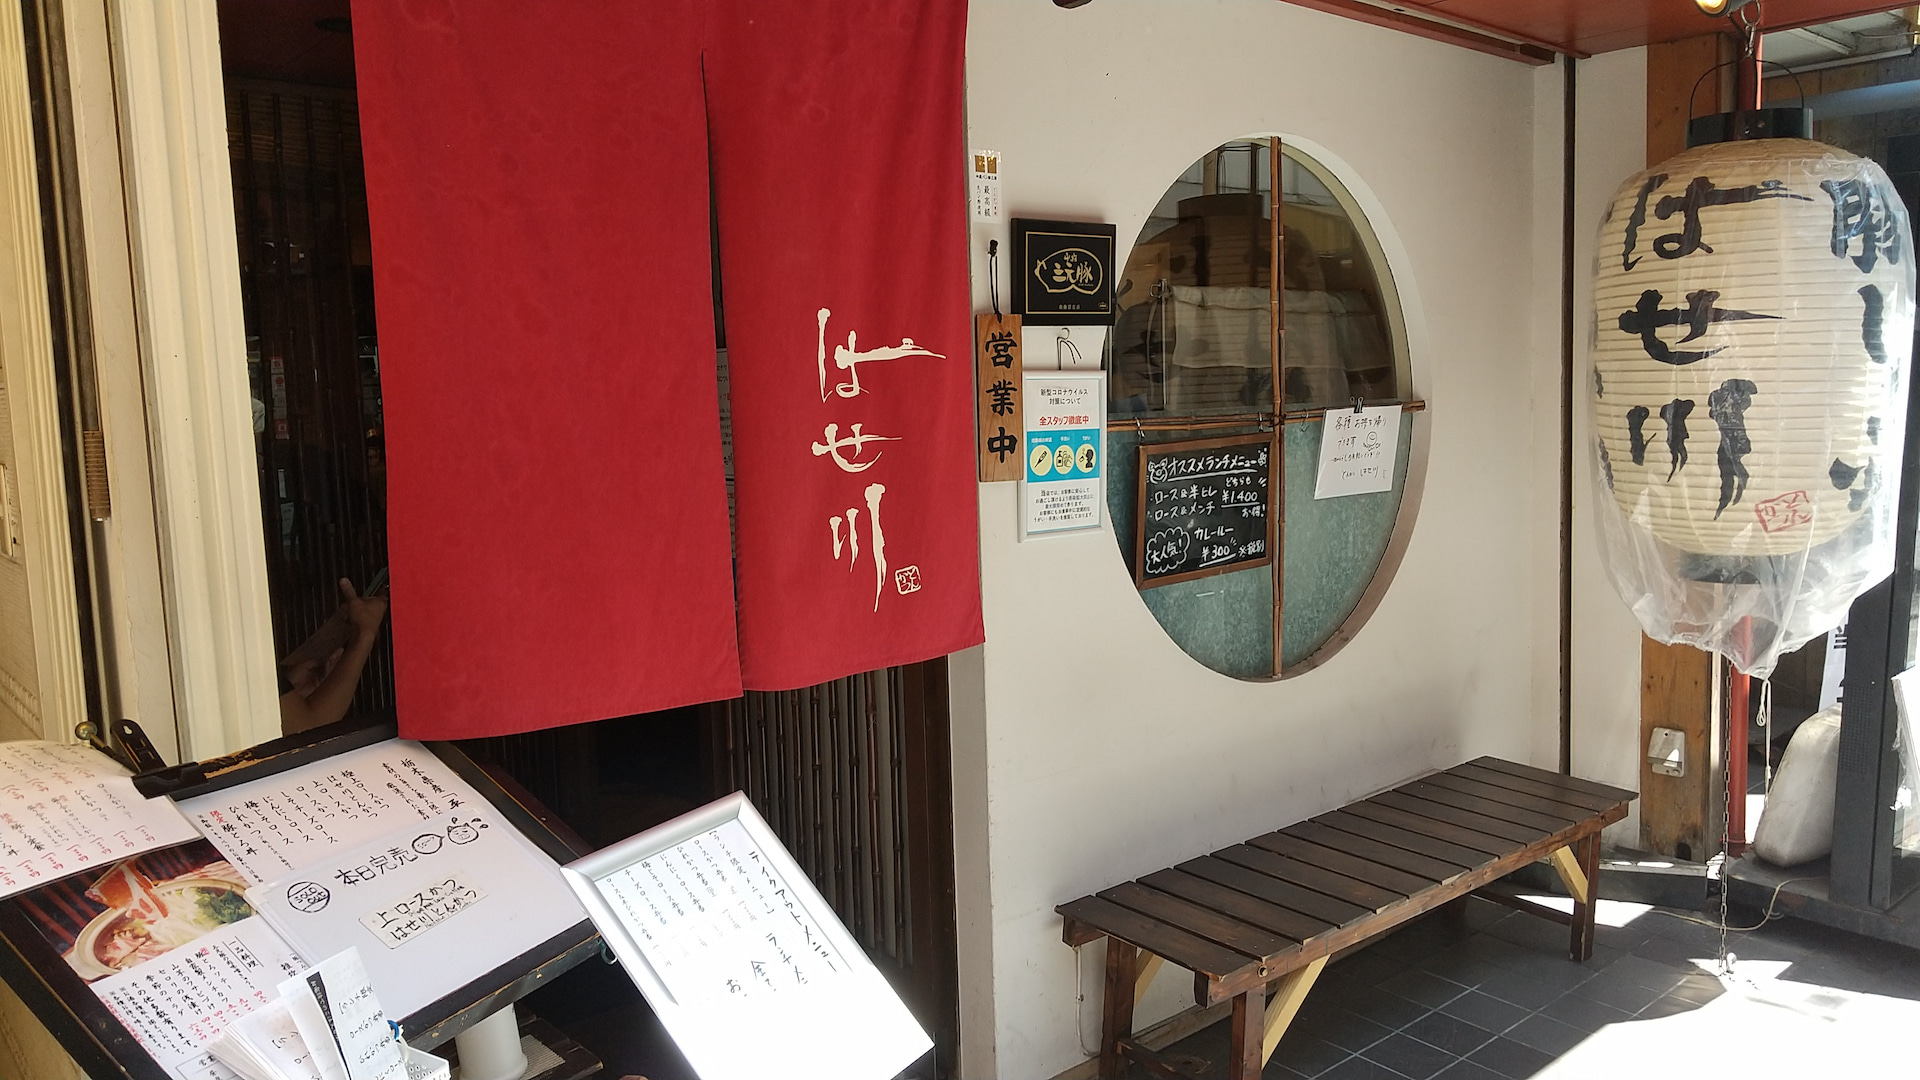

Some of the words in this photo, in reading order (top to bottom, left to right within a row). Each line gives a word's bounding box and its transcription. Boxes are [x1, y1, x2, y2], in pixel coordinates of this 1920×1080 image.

[1617, 172, 1814, 521] はせ川
[985, 331, 1018, 464] 営業中
[1039, 415, 1089, 426] 全スタッフ徹底中
[811, 307, 947, 613] はせ川
[1167, 454, 1258, 477] オススメランチメニュー
[1225, 476, 1252, 487] どちらも
[1194, 525, 1235, 541] カレールー
[296, 786, 335, 818] ロースかつ
[312, 781, 358, 819] 上ロースかつ
[327, 775, 377, 817] はせ川とんかつ
[341, 770, 389, 808] 極上ロースかつ
[229, 806, 261, 834] ひれかつ
[263, 796, 314, 842] にんにくロース
[281, 792, 338, 844] しそチーズロース
[334, 846, 419, 886] 本日完売
[390, 890, 477, 940] はせ川とんかつ
[748, 851, 837, 973] テイクアウトメニュー
[229, 941, 258, 968] 一品料理
